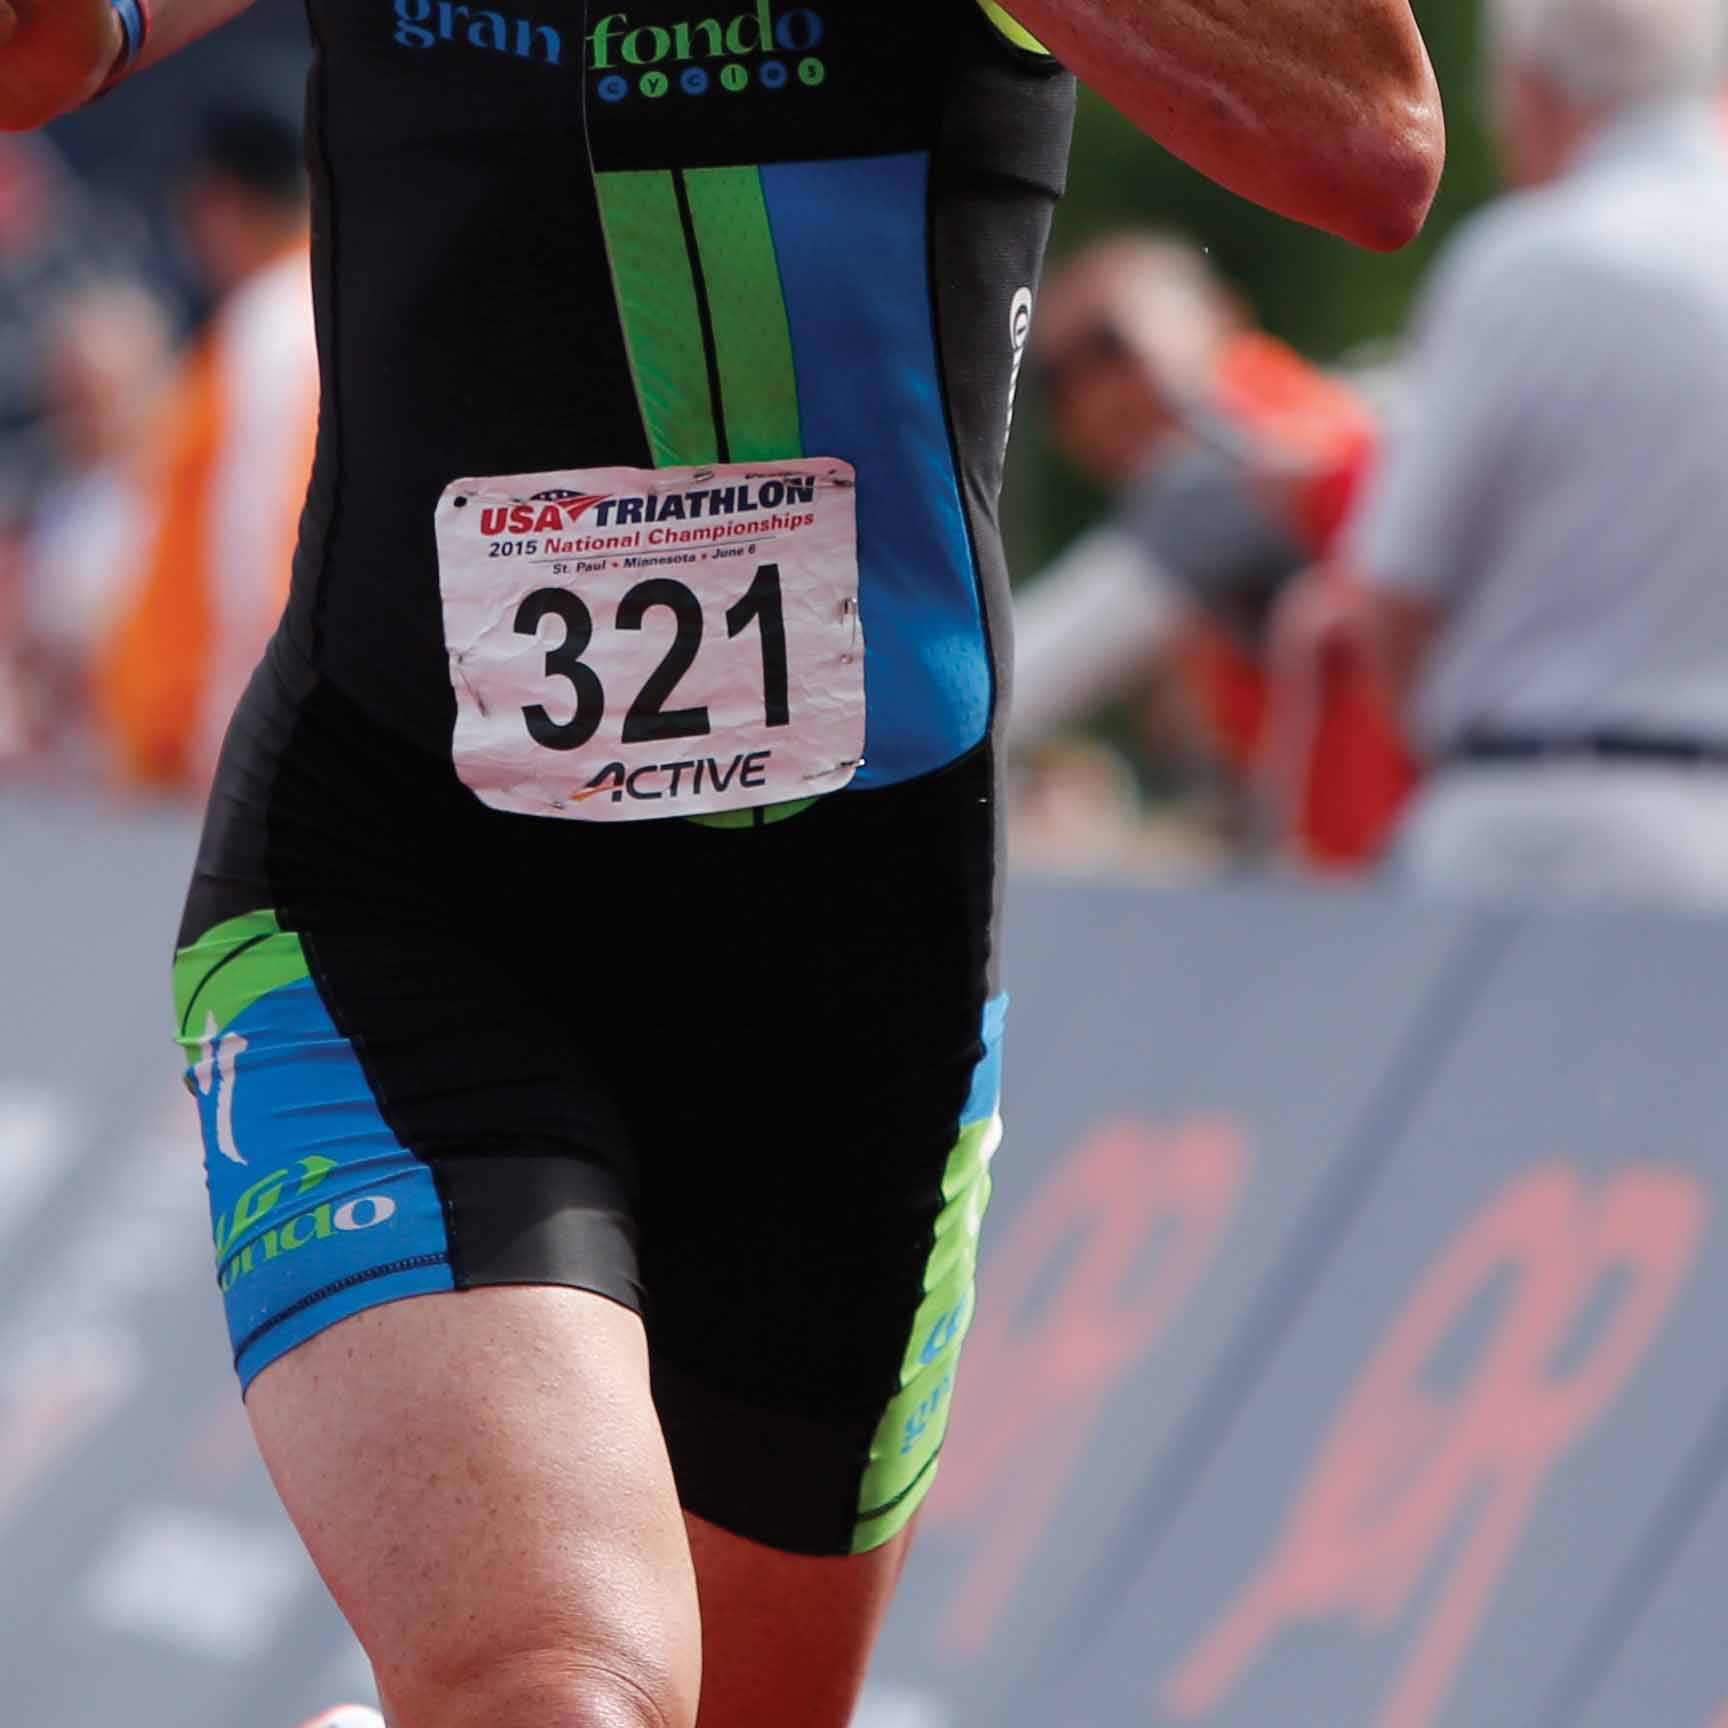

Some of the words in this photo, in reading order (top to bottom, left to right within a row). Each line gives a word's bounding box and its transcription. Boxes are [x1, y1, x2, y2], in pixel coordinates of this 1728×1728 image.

[480, 504, 563, 536] USA
[594, 475, 815, 527] TRIATHLON
[488, 539, 538, 558] 2015
[544, 531, 641, 554] National
[647, 512, 815, 545] Championships
[575, 560, 607, 573] Paul
[623, 552, 697, 569] Minnesota
[711, 547, 744, 560] June
[513, 563, 790, 751] 321
[571, 750, 771, 803] ACTIVE
